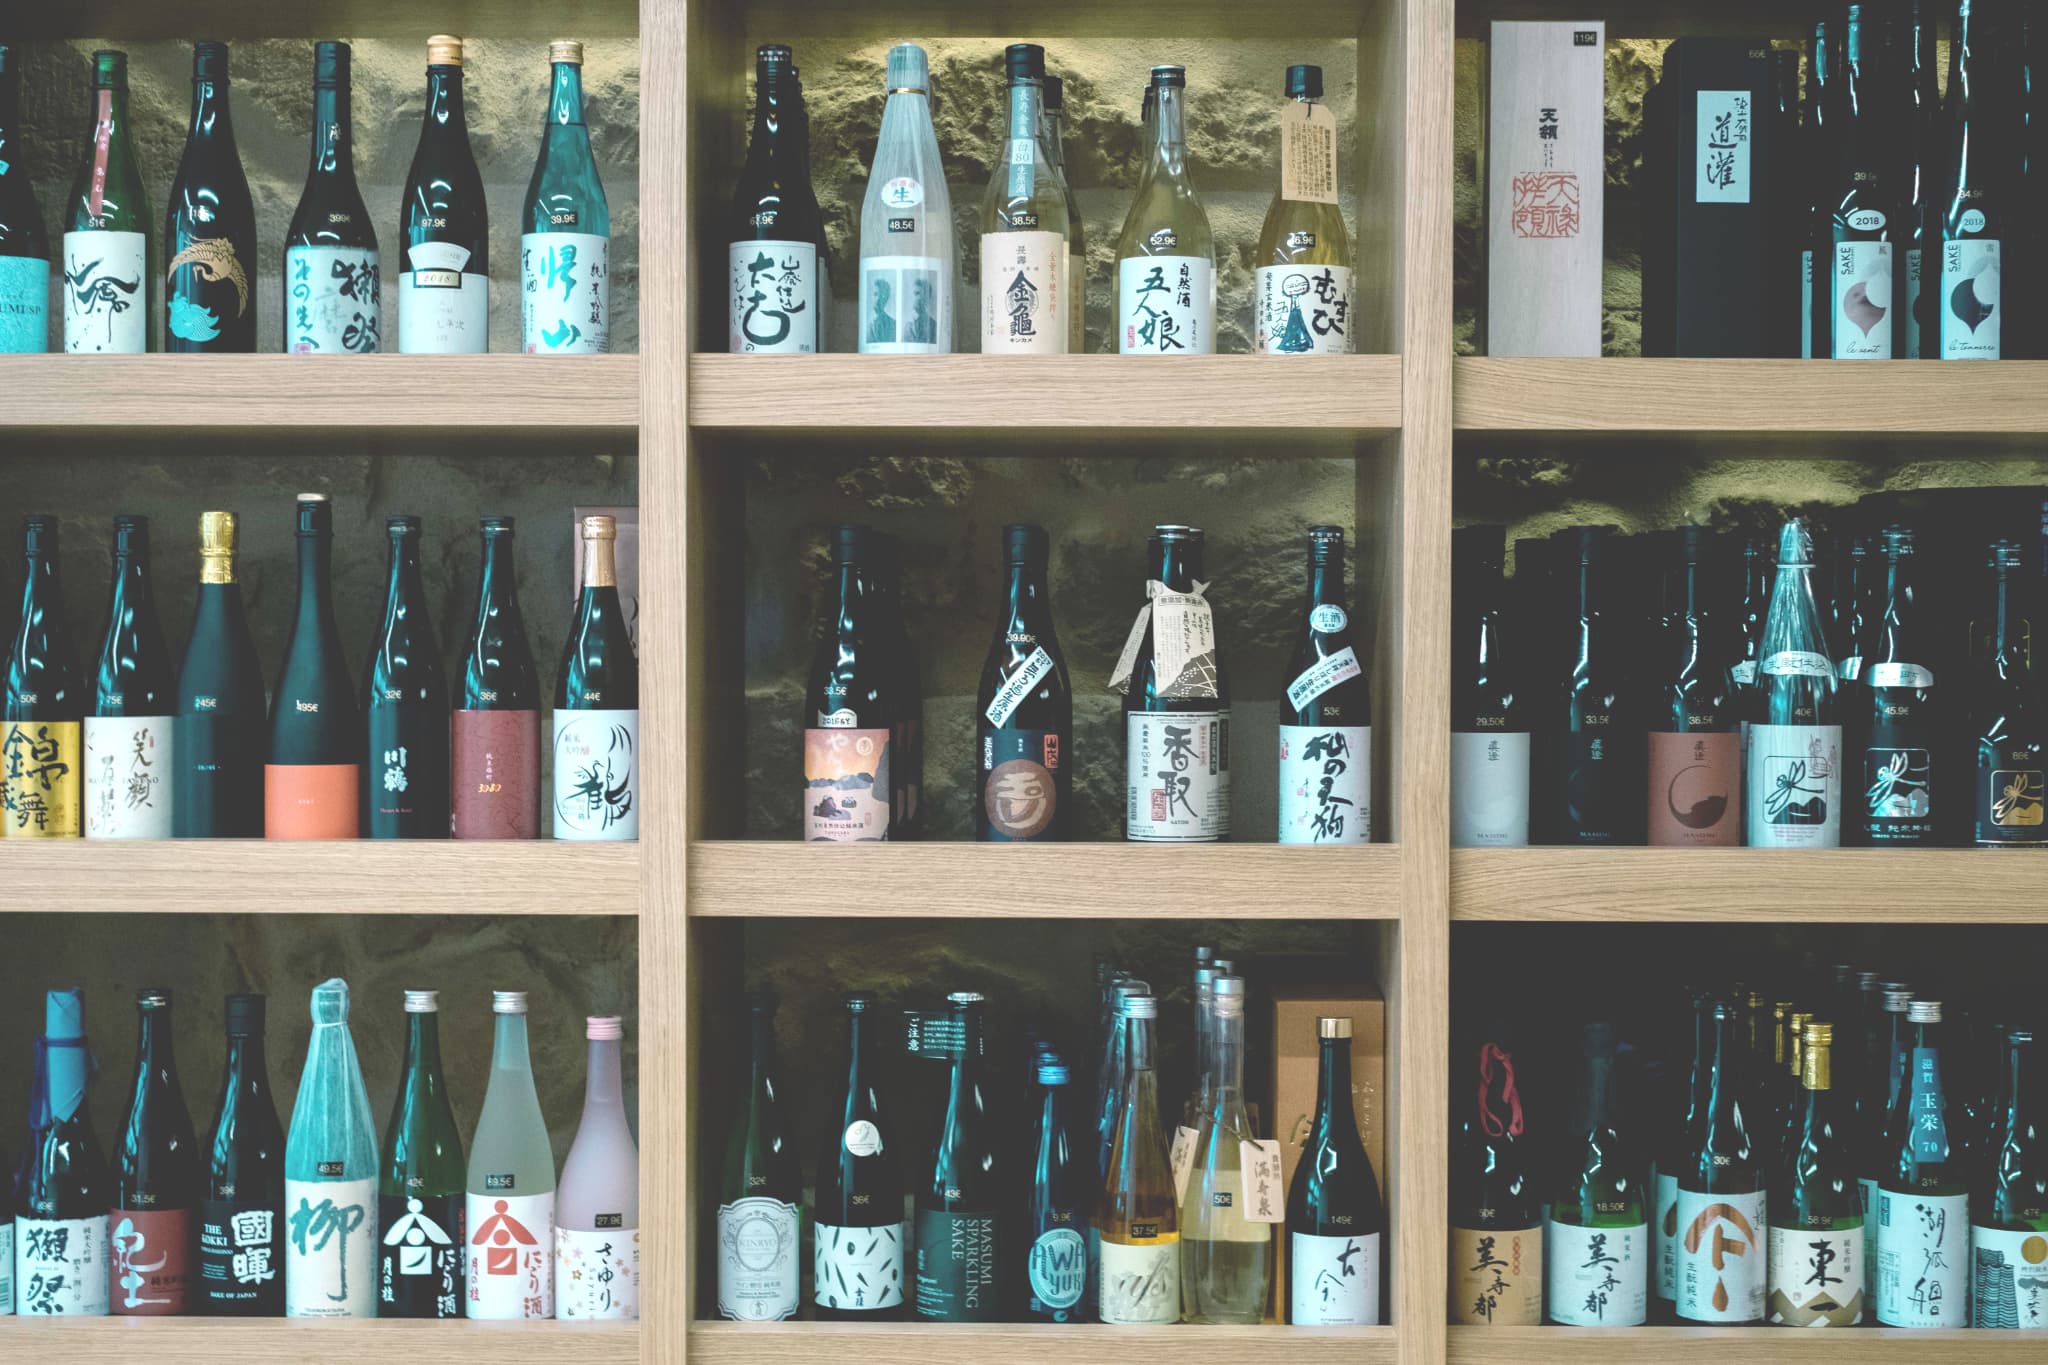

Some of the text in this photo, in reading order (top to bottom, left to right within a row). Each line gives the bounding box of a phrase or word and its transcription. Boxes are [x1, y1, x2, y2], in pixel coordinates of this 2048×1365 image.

[1574, 34, 1596, 44] 119€
[1015, 153, 1030, 162] 80
[890, 186, 915, 204] 生
[421, 217, 447, 228] 97.9€
[551, 214, 576, 225] 39.9€
[889, 220, 915, 231] 48.5€
[1011, 215, 1037, 226] 38.5€
[1855, 216, 1880, 226] 2018
[1963, 216, 1985, 226] 2018
[1841, 246, 1852, 275] SAKE
[1948, 244, 1959, 273] SAKE
[1177, 262, 1192, 308] 自然酒
[1132, 266, 1185, 352] 五人娘
[1320, 611, 1342, 622] 生酒
[20, 694, 38, 703] 50€
[385, 690, 402, 699] 32€
[480, 692, 498, 701] 36€
[584, 692, 601, 701] 44€
[1324, 706, 1340, 716] 53€
[1476, 717, 1505, 726] 29.50€
[1157, 725, 1200, 818] 香取
[17, 792, 48, 831] 舞
[1919, 1092, 1938, 1131] 玉栄
[1922, 1141, 1938, 1153] 70
[1714, 1155, 1731, 1166] 30€
[945, 1189, 961, 1199] 43€
[204, 1223, 222, 1235] THE
[201, 1234, 228, 1247] KOKKI
[951, 1219, 964, 1260] SAKE
[231, 1210, 276, 1285] 國暉
[290, 1197, 365, 1302] 柳
[980, 1219, 992, 1284] MASUMI
[965, 1218, 979, 1309] SPARKLING
[25, 1226, 72, 1315] 獺祭
[595, 1242, 614, 1312] さゆり
[437, 1249, 456, 1318] にごり酒
[524, 1251, 543, 1319] にごり酒
